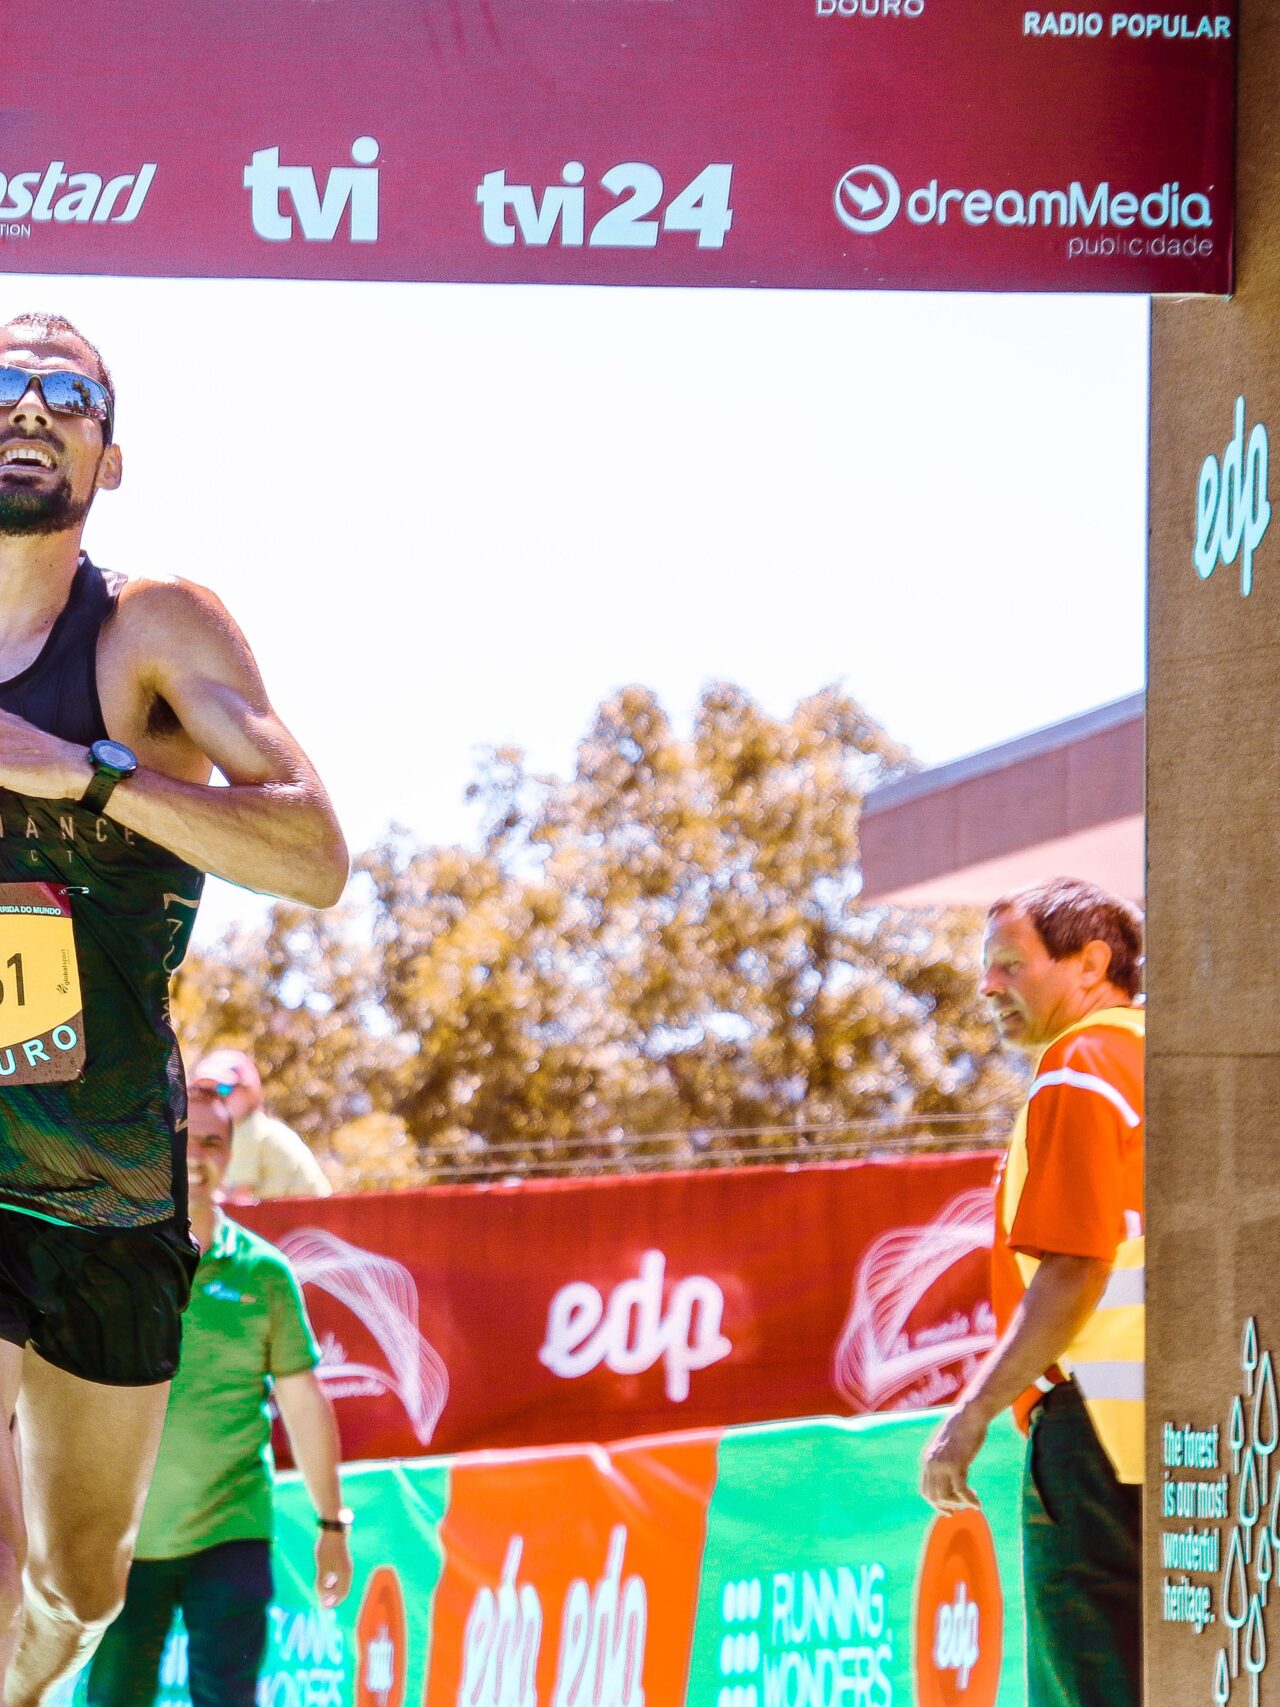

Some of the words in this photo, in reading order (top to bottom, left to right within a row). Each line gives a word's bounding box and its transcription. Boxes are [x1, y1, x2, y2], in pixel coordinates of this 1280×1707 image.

[1023, 11, 1103, 37] RADIO
[1111, 12, 1232, 39] POPULAR
[243, 135, 380, 242] tvi
[906, 178, 1213, 229] dreamMedia
[1066, 235, 1214, 259] publicidade
[1192, 394, 1272, 597] edp
[20, 906, 32, 914] DO
[32, 906, 62, 916] MUNDO
[539, 1248, 733, 1402] edp
[1163, 1421, 1184, 1466] the
[1184, 1423, 1219, 1468] forest
[1163, 1471, 1175, 1517] is
[1176, 1481, 1197, 1518] our
[1197, 1473, 1229, 1518] most
[1162, 1526, 1219, 1572] wonderful
[771, 1562, 886, 1645] RUNNING
